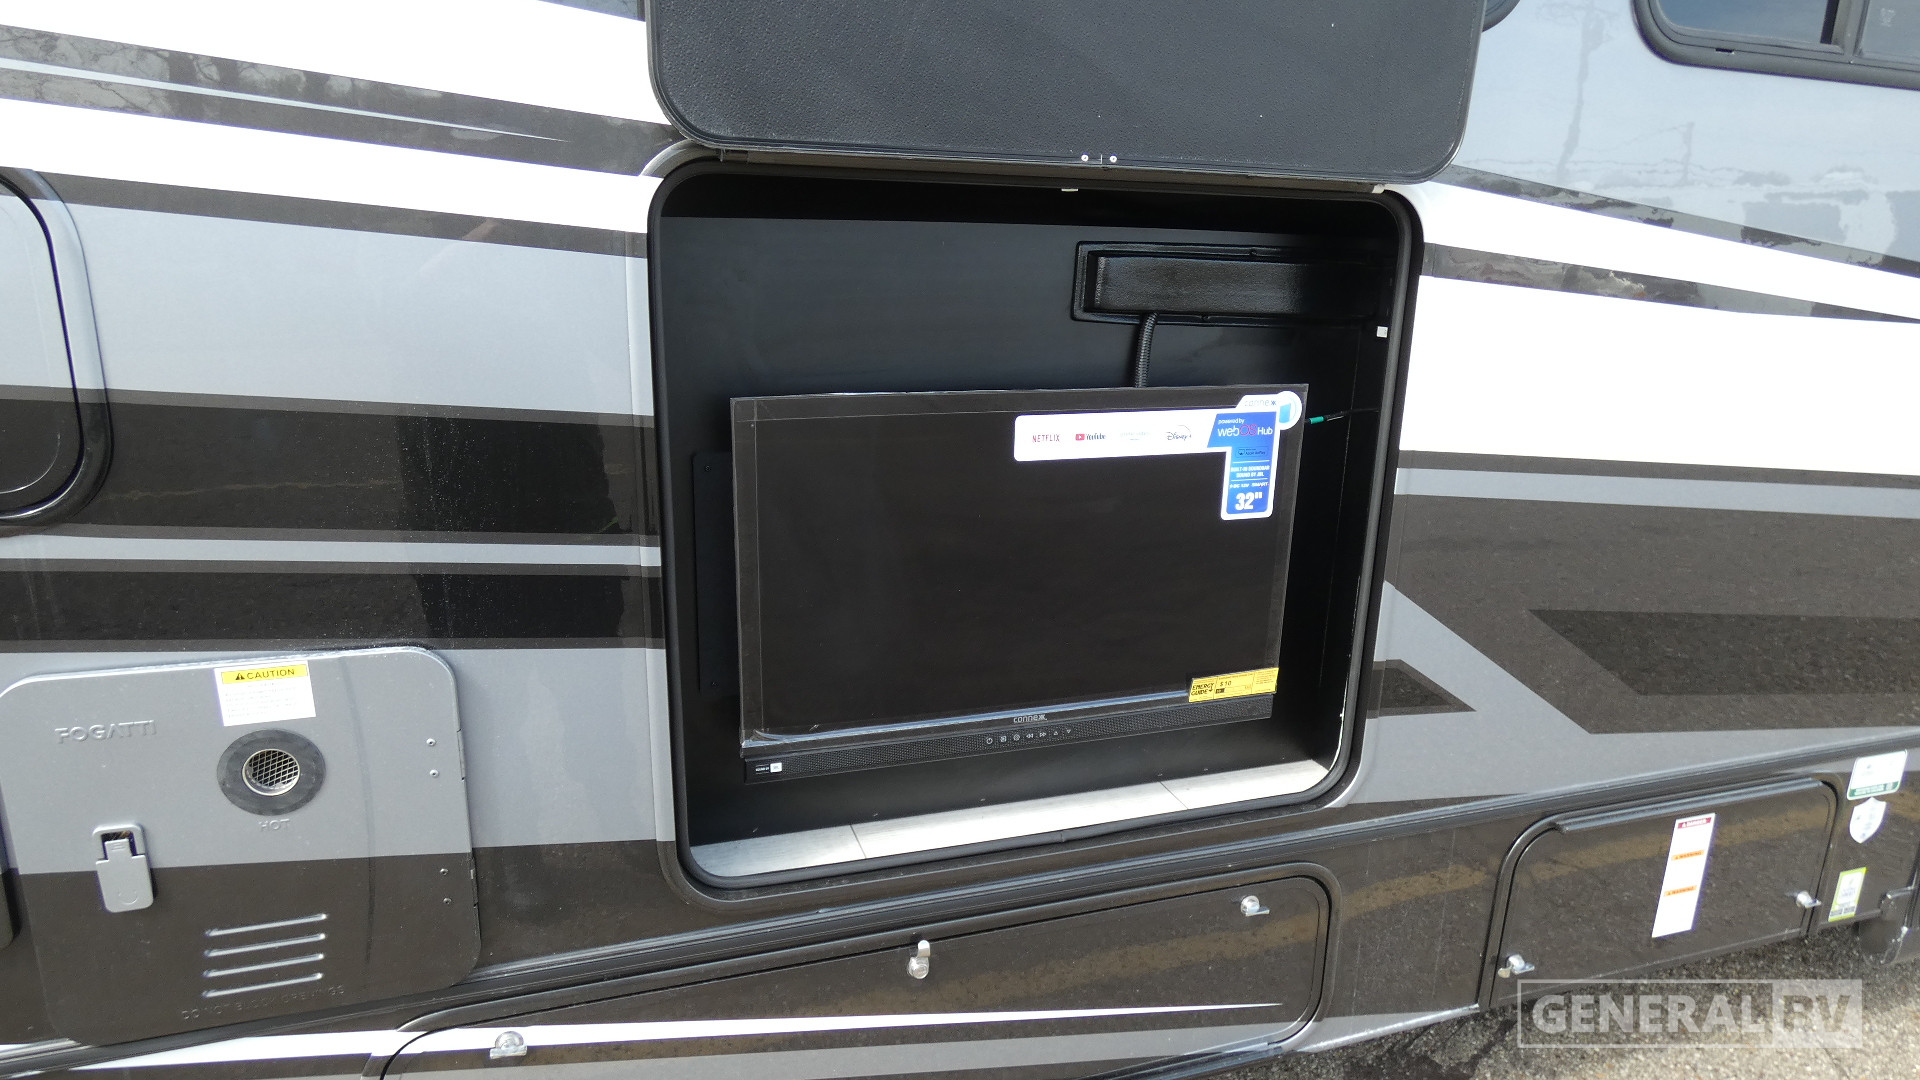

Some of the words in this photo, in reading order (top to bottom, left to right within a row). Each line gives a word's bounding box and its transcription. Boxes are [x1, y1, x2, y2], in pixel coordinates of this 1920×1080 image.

[1086, 432, 1106, 441] YouTube
[1257, 426, 1274, 436] Hub
[1032, 433, 1061, 443] NETFLIX
[1235, 491, 1263, 511] 32"
[246, 668, 295, 680] CAUTION
[54, 719, 157, 744] FOGATTI
[258, 818, 291, 832] HOT
